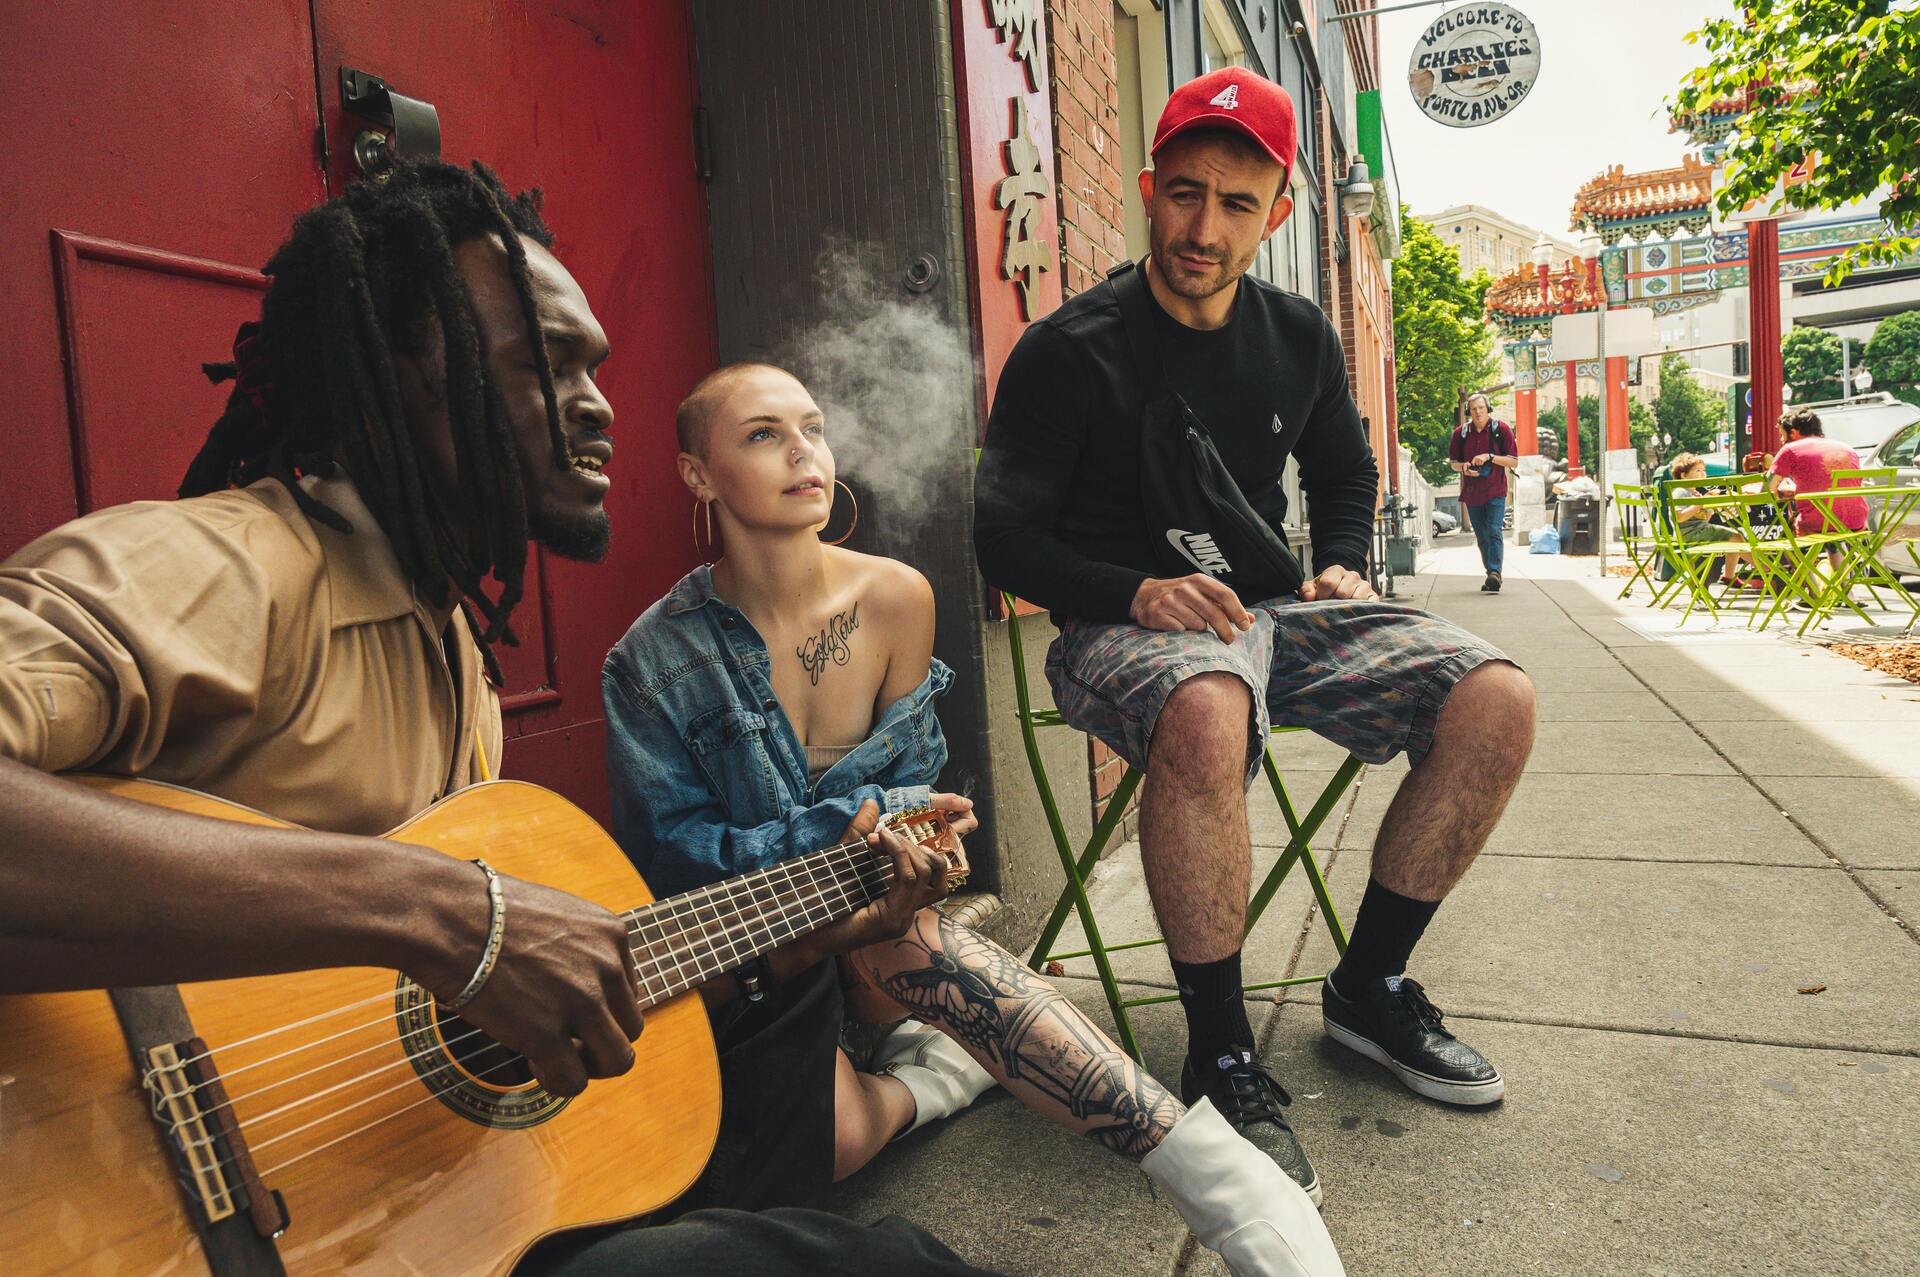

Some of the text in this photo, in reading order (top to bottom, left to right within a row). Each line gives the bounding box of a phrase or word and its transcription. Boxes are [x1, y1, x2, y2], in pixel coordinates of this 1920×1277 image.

[1421, 9, 1523, 47] WELCOME TO
[1209, 84, 1238, 110] 4
[1184, 533, 1232, 574] NIKE
